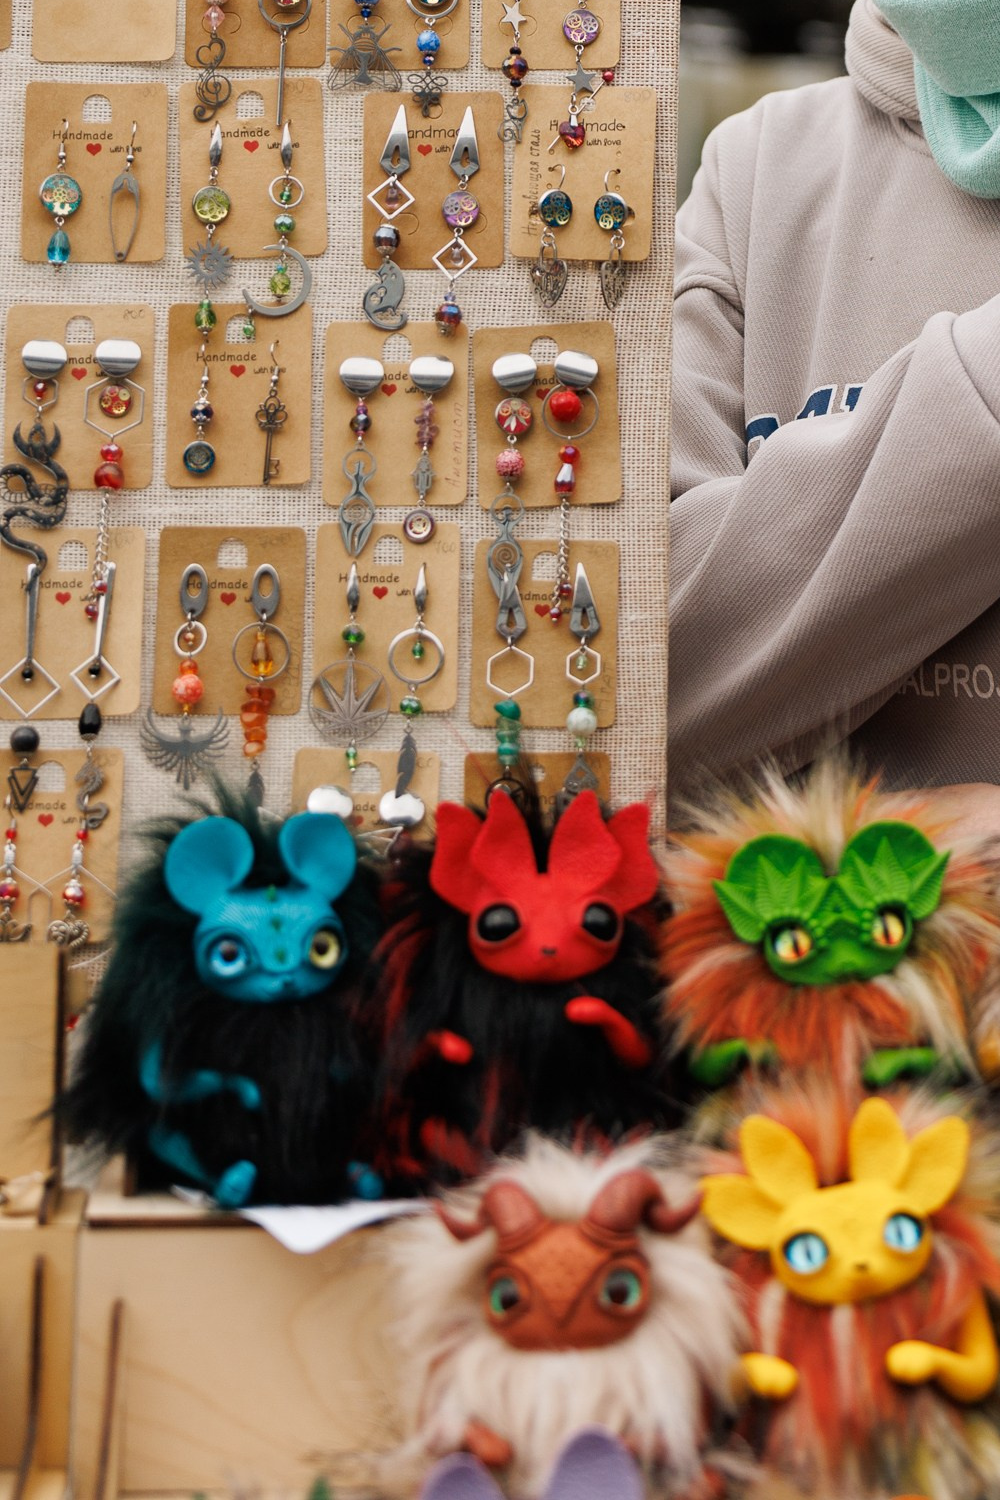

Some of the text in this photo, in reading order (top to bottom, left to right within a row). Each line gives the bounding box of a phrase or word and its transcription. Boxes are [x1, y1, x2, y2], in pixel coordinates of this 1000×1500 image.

[53, 129, 113, 141] Handmade
[604, 138, 621, 147] love
[339, 573, 400, 583] Hndmade
